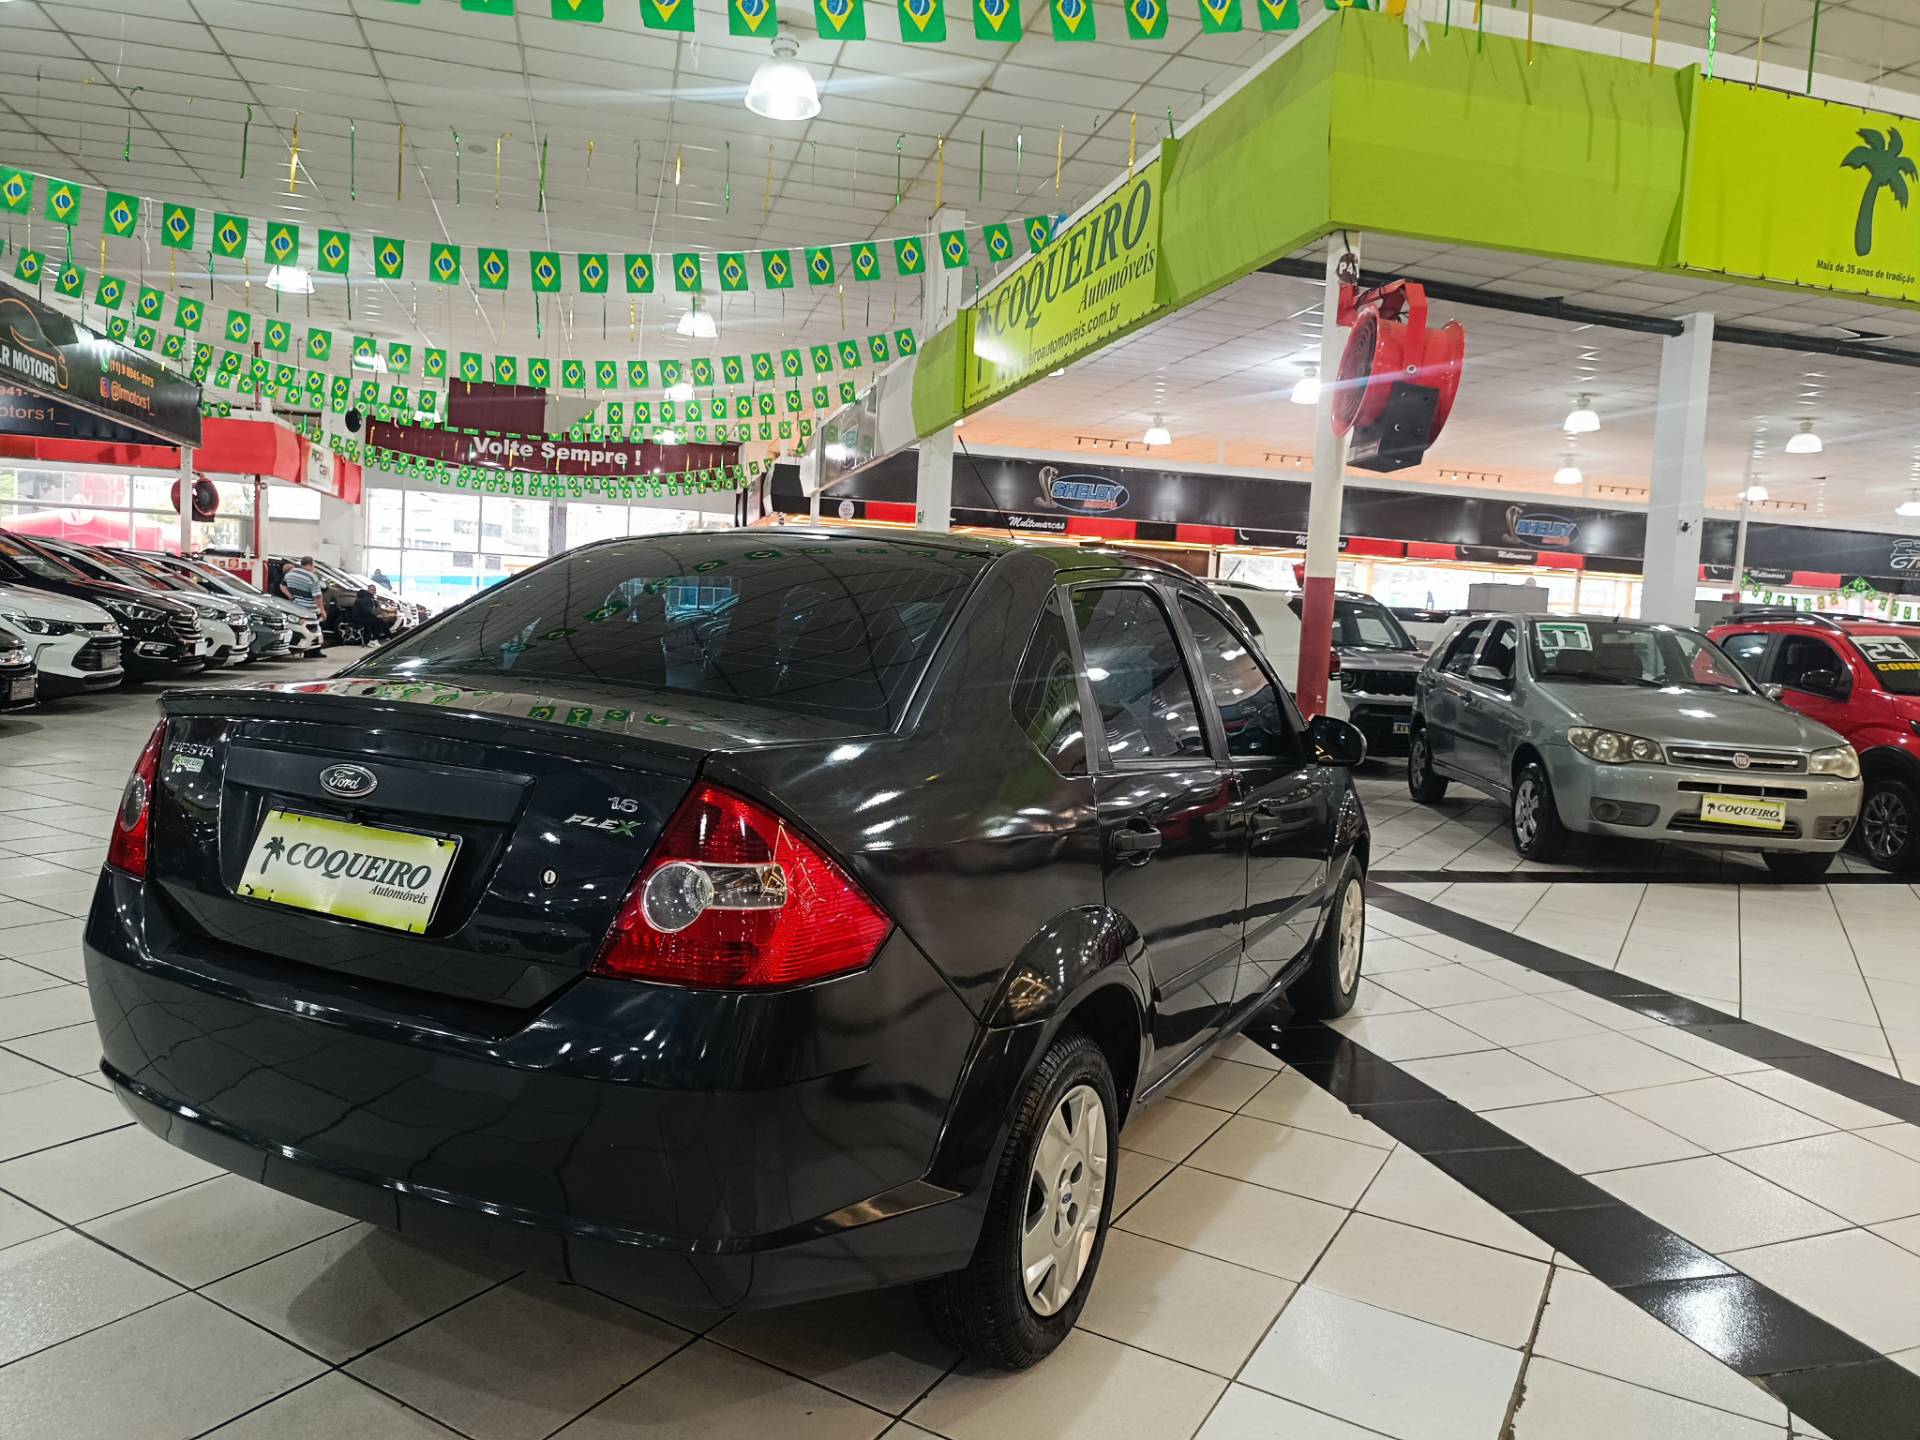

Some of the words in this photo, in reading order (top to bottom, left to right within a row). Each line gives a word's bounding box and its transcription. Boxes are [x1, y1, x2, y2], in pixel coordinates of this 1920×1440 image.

[993, 179, 1151, 337] COQUEIRO
[1816, 259, 1833, 271] Mais
[1835, 263, 1844, 273] de
[1846, 264, 1855, 274] 35
[1857, 267, 1874, 278] anos
[1876, 269, 1884, 279] de
[1077, 241, 1156, 314] Automóveis
[12, 349, 56, 385] MOTORS
[473, 436, 534, 456] Volte
[541, 442, 628, 467] Sempre
[1050, 480, 1125, 503] SHELBY
[1863, 643, 1916, 660] 24
[169, 741, 214, 758] FIESTA
[329, 769, 362, 790] Ford
[1717, 803, 1780, 819] COQUEIRO
[563, 814, 642, 838] FLEX
[286, 842, 432, 890] COQUEIRO
[368, 884, 429, 905] Automóveis
